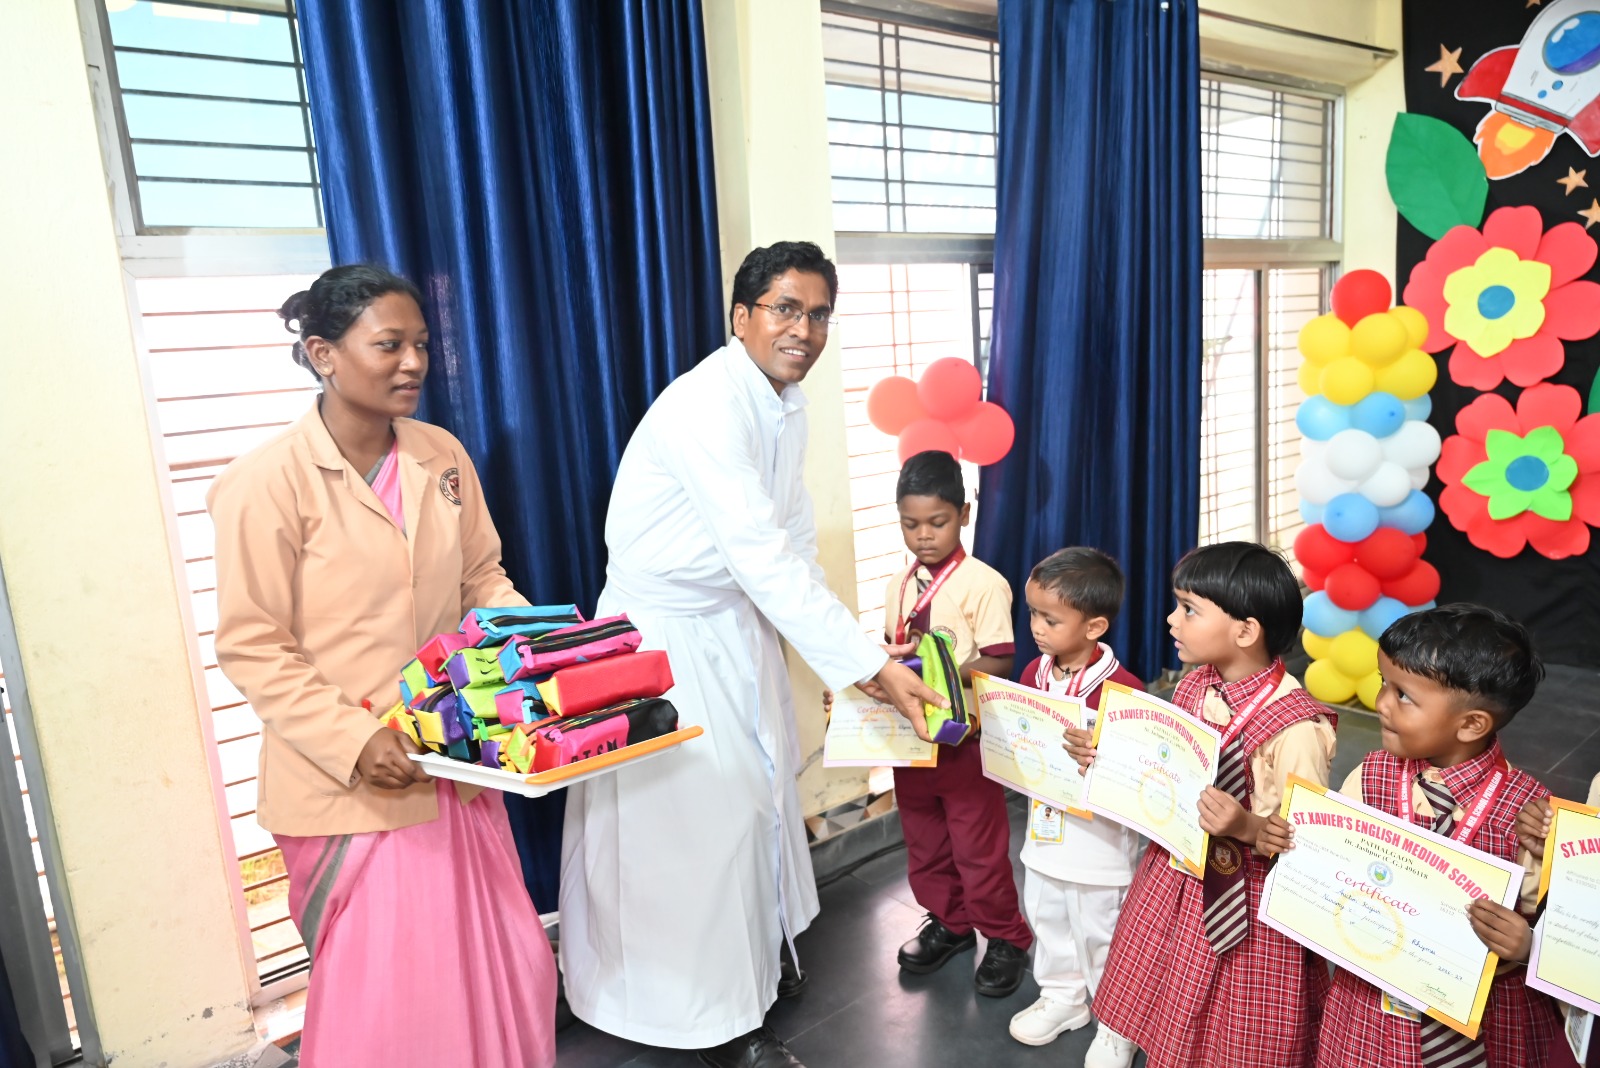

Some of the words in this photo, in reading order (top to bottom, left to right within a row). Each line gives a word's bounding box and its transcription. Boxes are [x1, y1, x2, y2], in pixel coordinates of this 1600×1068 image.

[857, 705, 901, 714] Certificat
[1006, 692, 1026, 704] ENGLISH
[1028, 698, 1050, 716] MEDIUM
[1007, 728, 1047, 748] Certificate
[1119, 708, 1150, 720] XAVIER'S
[1150, 710, 1174, 728] ENGLISH
[1175, 720, 1194, 746] MEDIUM
[1192, 740, 1210, 771] SCHOOL
[1138, 754, 1181, 784] Certificate
[1472, 798, 1488, 816] SCHOOL
[1293, 812, 1308, 826] ST.
[1308, 812, 1352, 830] XAVIER'S
[1355, 819, 1402, 847] ENGLISH
[1402, 838, 1450, 874] MEDIUM
[1448, 868, 1489, 900] SCHOO
[1354, 842, 1382, 859] Jashpur
[1360, 838, 1414, 865] PATHALGAON
[1560, 841, 1578, 858] ST.
[1336, 870, 1420, 916] Certificate
